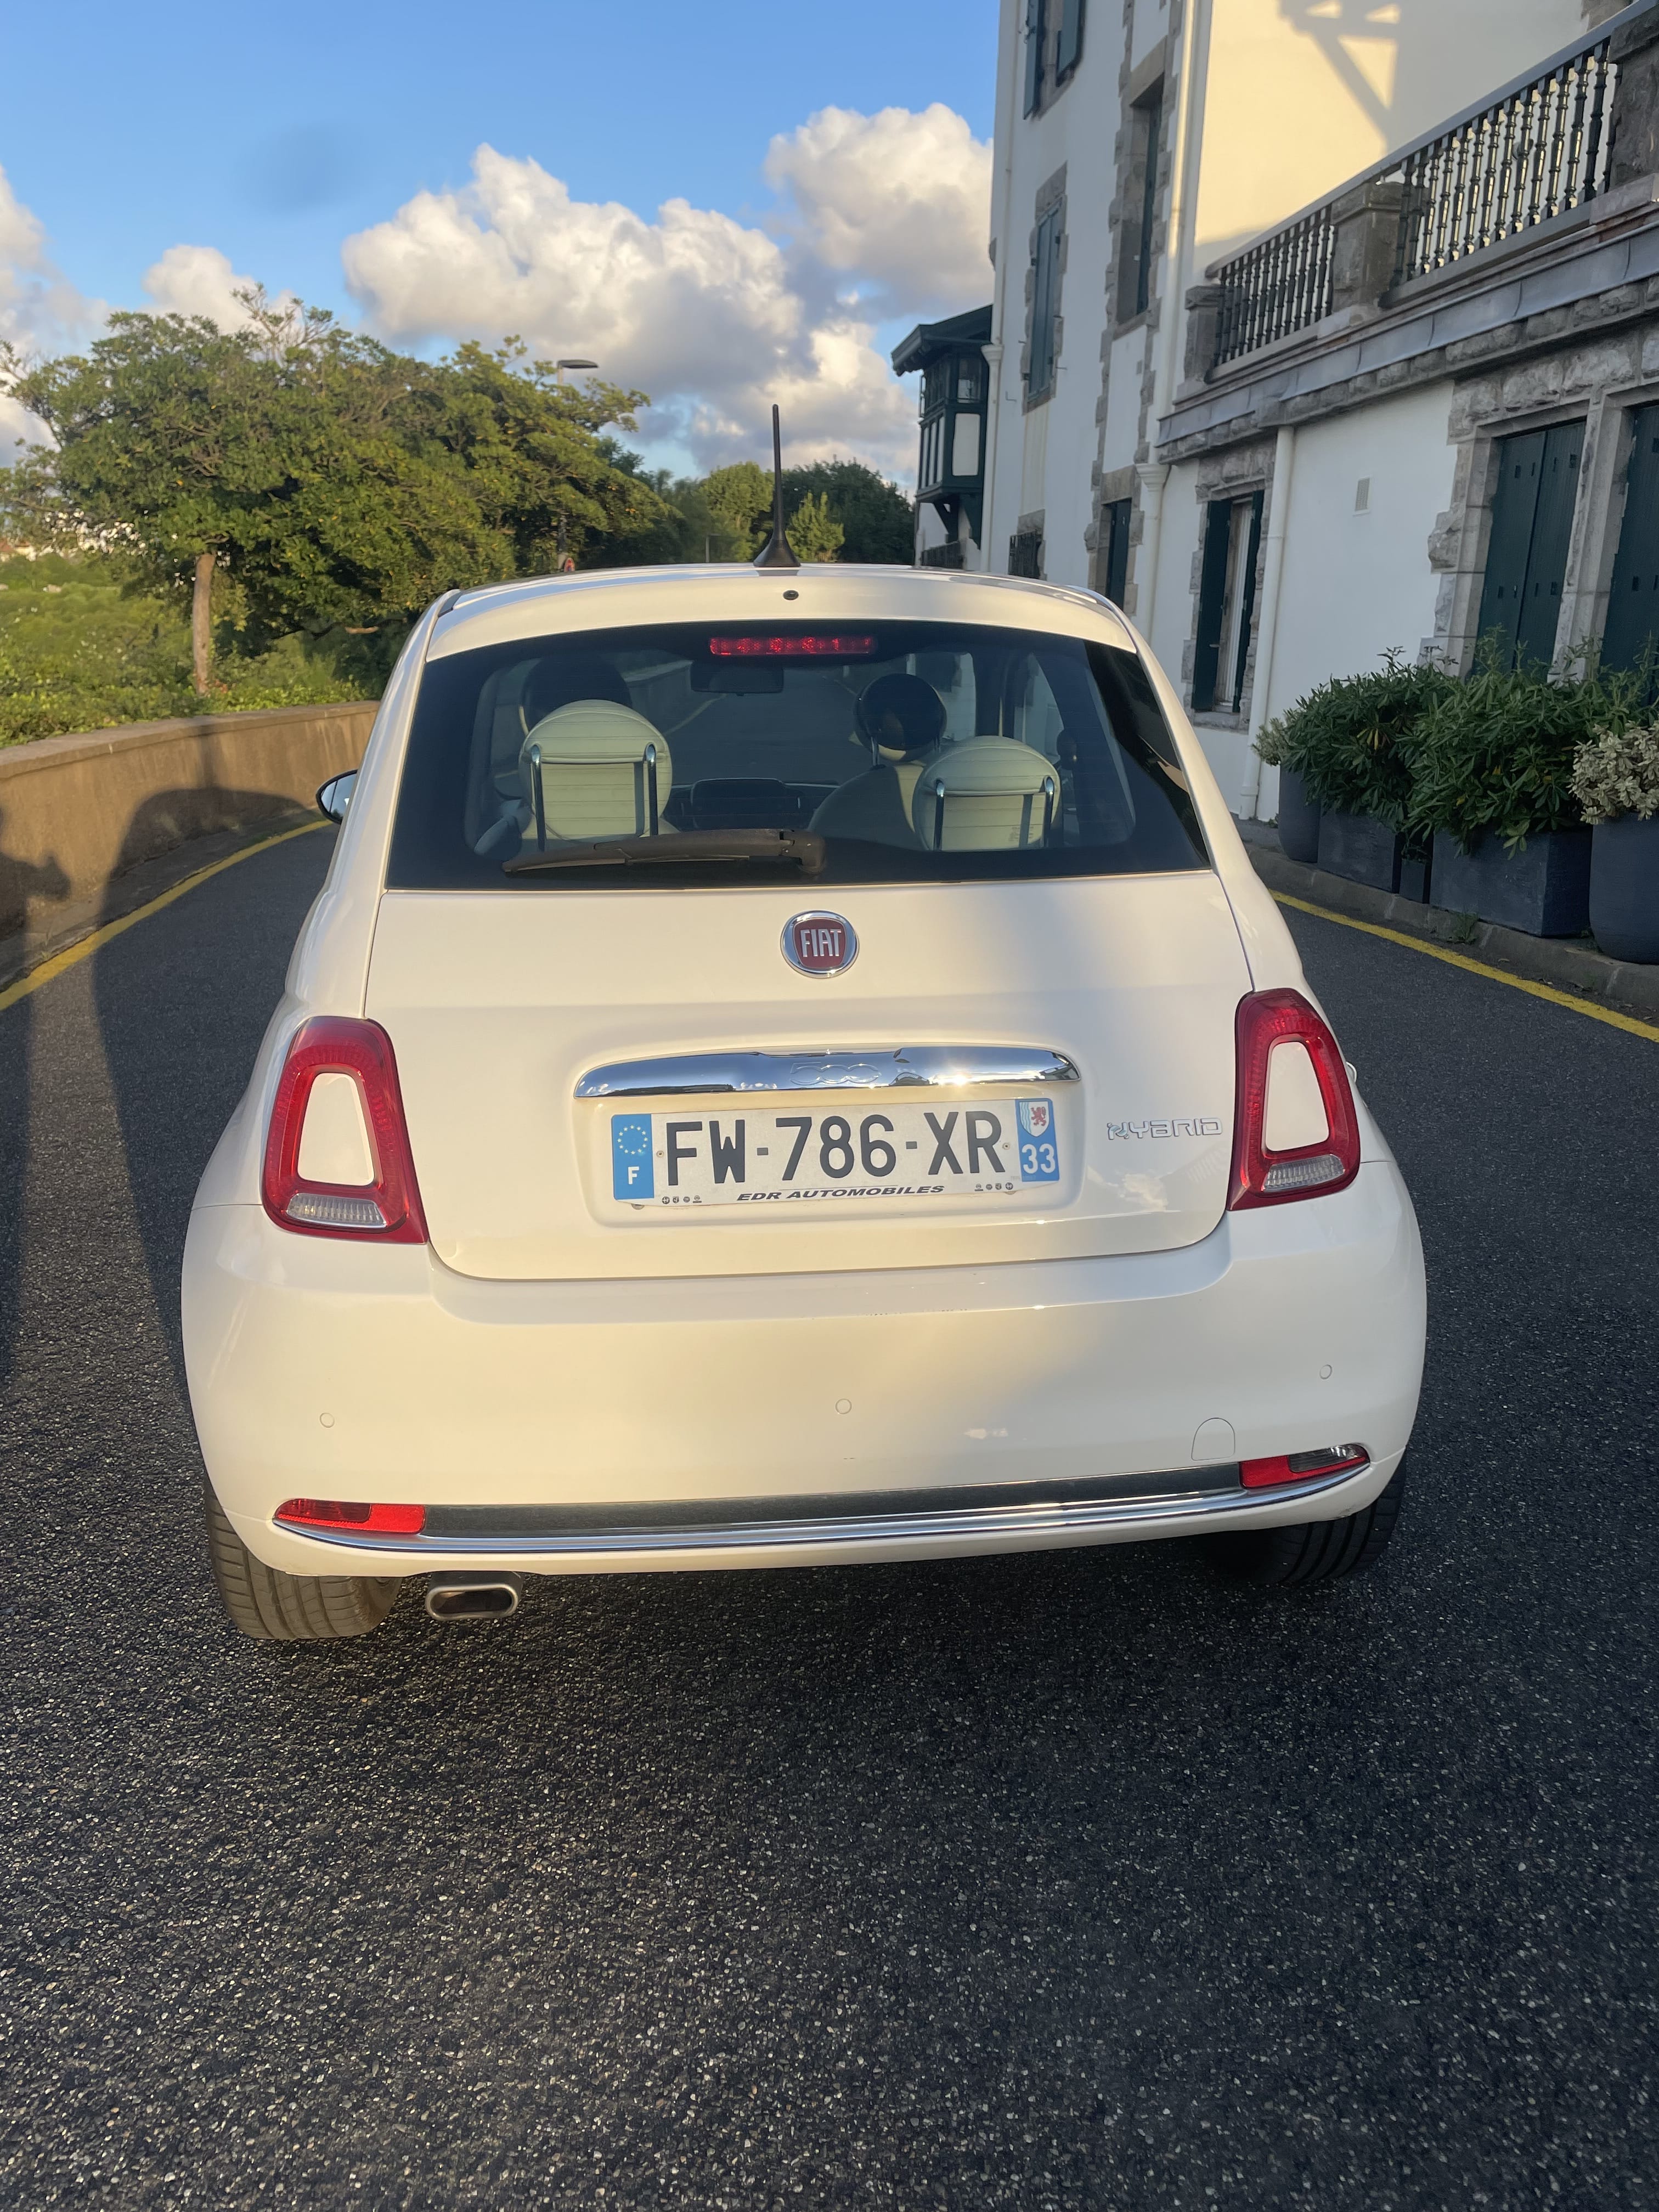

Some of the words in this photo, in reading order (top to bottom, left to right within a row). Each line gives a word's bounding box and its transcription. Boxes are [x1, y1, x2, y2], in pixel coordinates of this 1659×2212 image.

[800, 929, 842, 957] FIAT
[789, 1061, 882, 1086] 500
[1107, 1118, 1223, 1141] HYBRID
[666, 1110, 1006, 1186] FW-786-XR
[1022, 1143, 1056, 1174] 33
[628, 1166, 640, 1185] F
[736, 1192, 780, 1201] EDR
[786, 1185, 945, 1199] AUTOMOBILES
